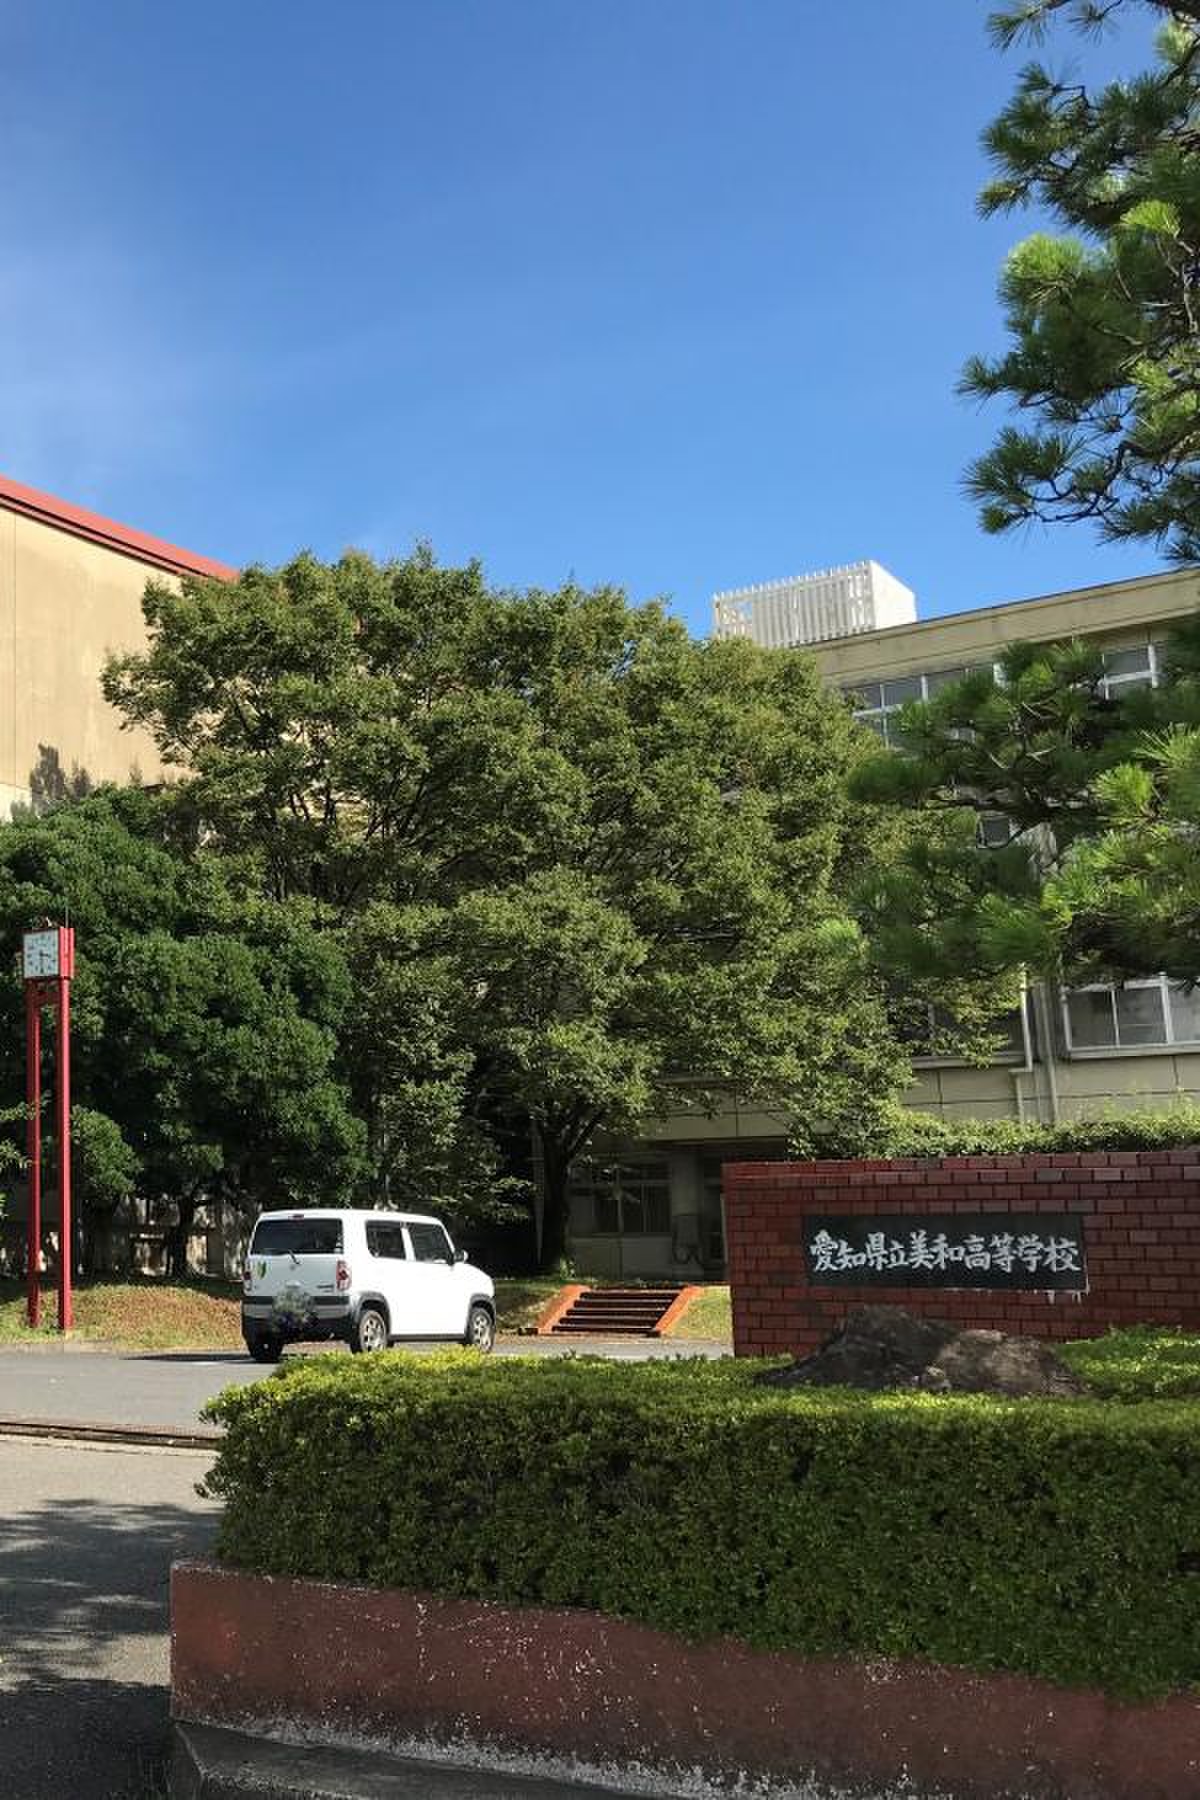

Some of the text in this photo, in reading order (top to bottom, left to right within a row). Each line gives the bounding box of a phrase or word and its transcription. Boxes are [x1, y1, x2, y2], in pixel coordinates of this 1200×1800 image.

[809, 1229, 1082, 1272] 愛知県立美和高等学校
